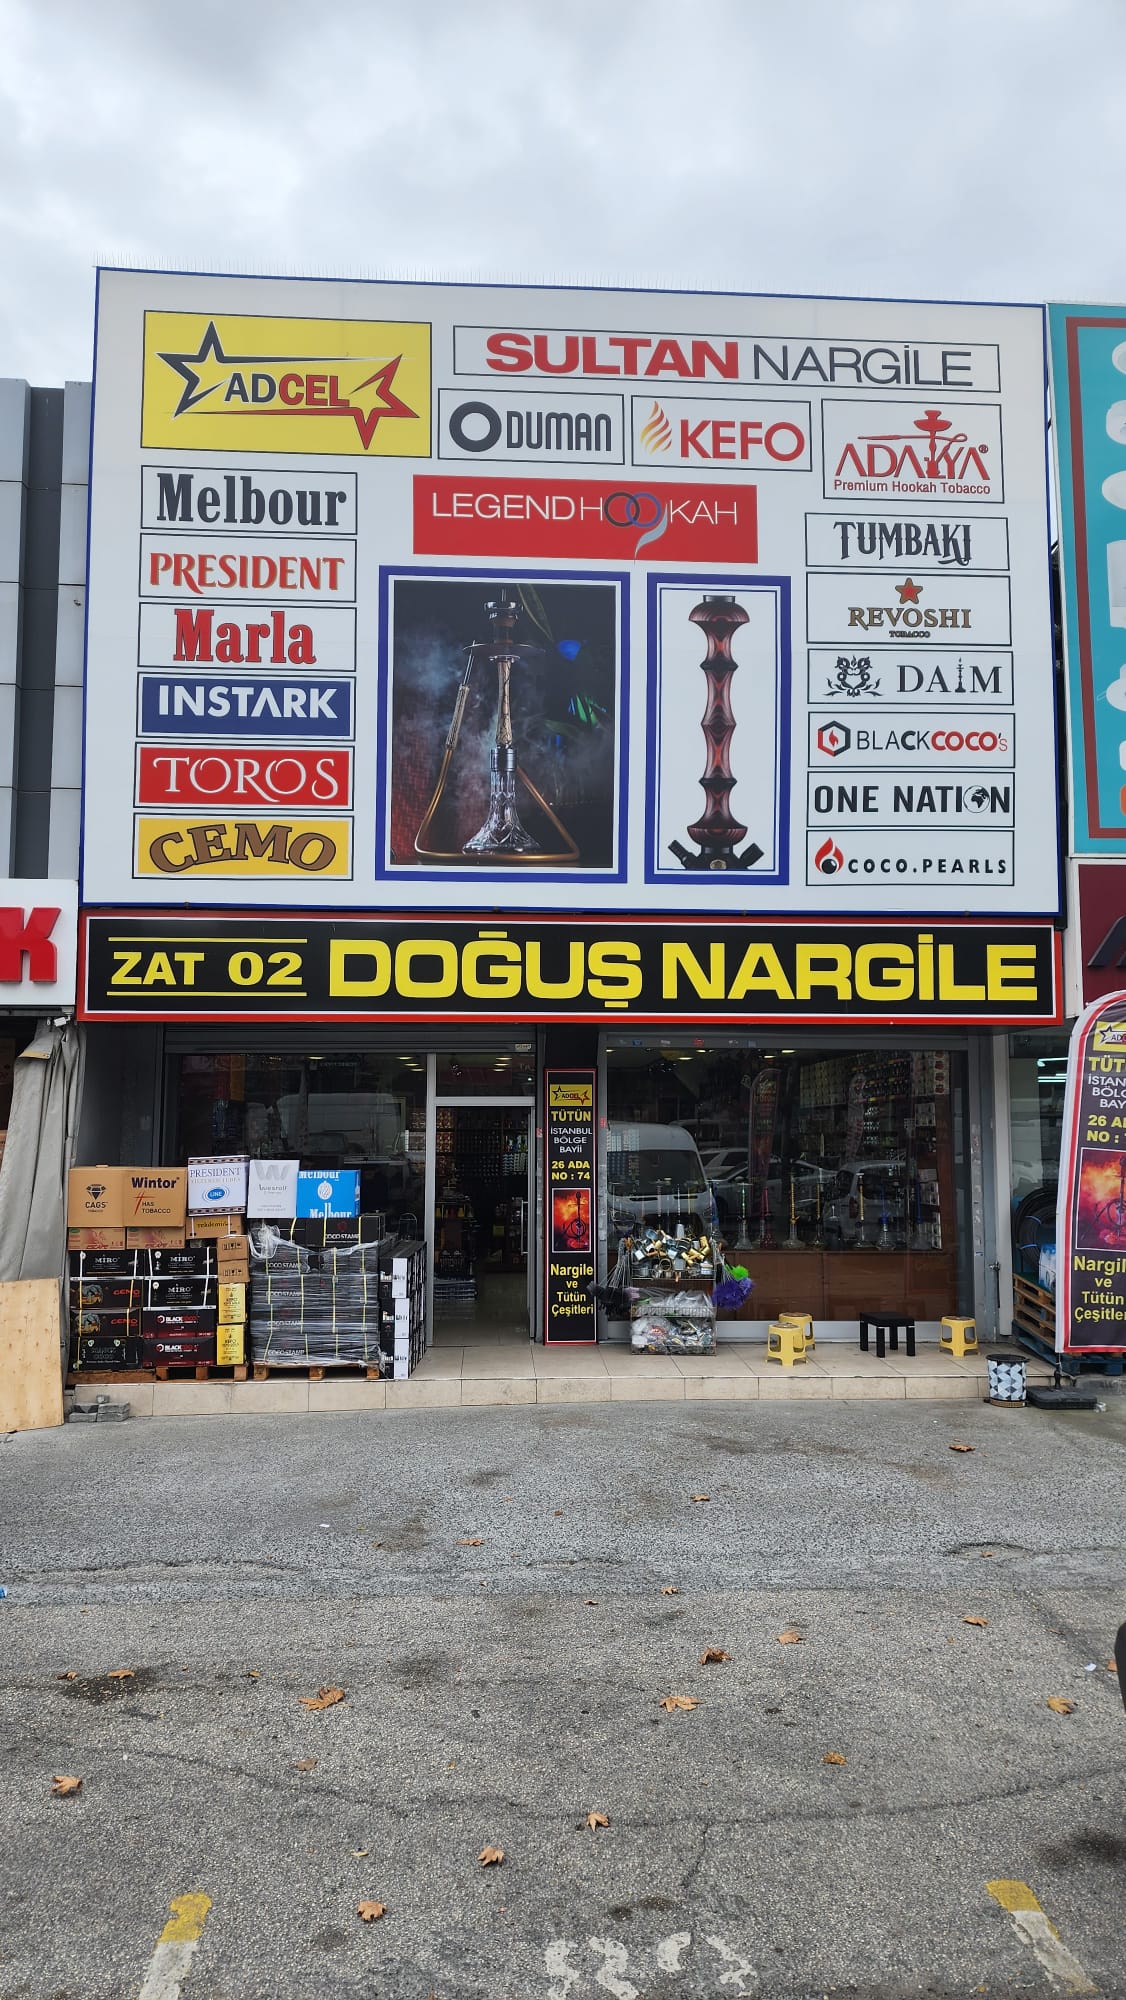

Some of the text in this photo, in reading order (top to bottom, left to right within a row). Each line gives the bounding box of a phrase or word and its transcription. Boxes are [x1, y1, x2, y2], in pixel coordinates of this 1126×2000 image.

[486, 332, 974, 387] SULTAN NARGİLE
[224, 372, 350, 407] ADCEL
[680, 419, 806, 462] KEFO
[834, 479, 991, 495] Premium Hookah Tobacco
[156, 473, 347, 526] Melbour
[833, 521, 972, 566] TUMBAKI
[149, 553, 345, 594] PRESIDENT
[848, 606, 971, 630] REVOSHI
[173, 608, 317, 665] Marla
[158, 685, 338, 719] INSTARK
[152, 757, 339, 803] TOROS
[814, 785, 879, 813] ONE
[149, 823, 337, 873] CEMO
[110, 951, 205, 986] ZAT
[227, 951, 303, 986] 02
[329, 931, 643, 1008] DOĞUŞ
[662, 934, 1038, 1001] NARGİLE
[1088, 1055, 1126, 1073] TÜT
[551, 1109, 591, 1121] TÜTÜN
[1088, 1114, 1107, 1126] 26
[550, 1126, 592, 1135] İSTANBUL
[1086, 1130, 1110, 1142] NO
[554, 1135, 587, 1143] BÖLGE
[190, 1168, 241, 1178] PRESIDENT
[551, 1161, 590, 1169] 26 ADA
[131, 1177, 176, 1188] Wintor
[551, 1172, 568, 1180] NO
[577, 1172, 590, 1180] 74
[550, 1264, 593, 1278] Nargile
[1074, 1256, 1126, 1276] Nargil
[566, 1280, 578, 1288] ve
[1094, 1278, 1112, 1288] ve
[557, 1292, 586, 1302] Tütün
[1081, 1291, 1124, 1305] Tütün
[551, 1304, 593, 1317] Çeşitleri
